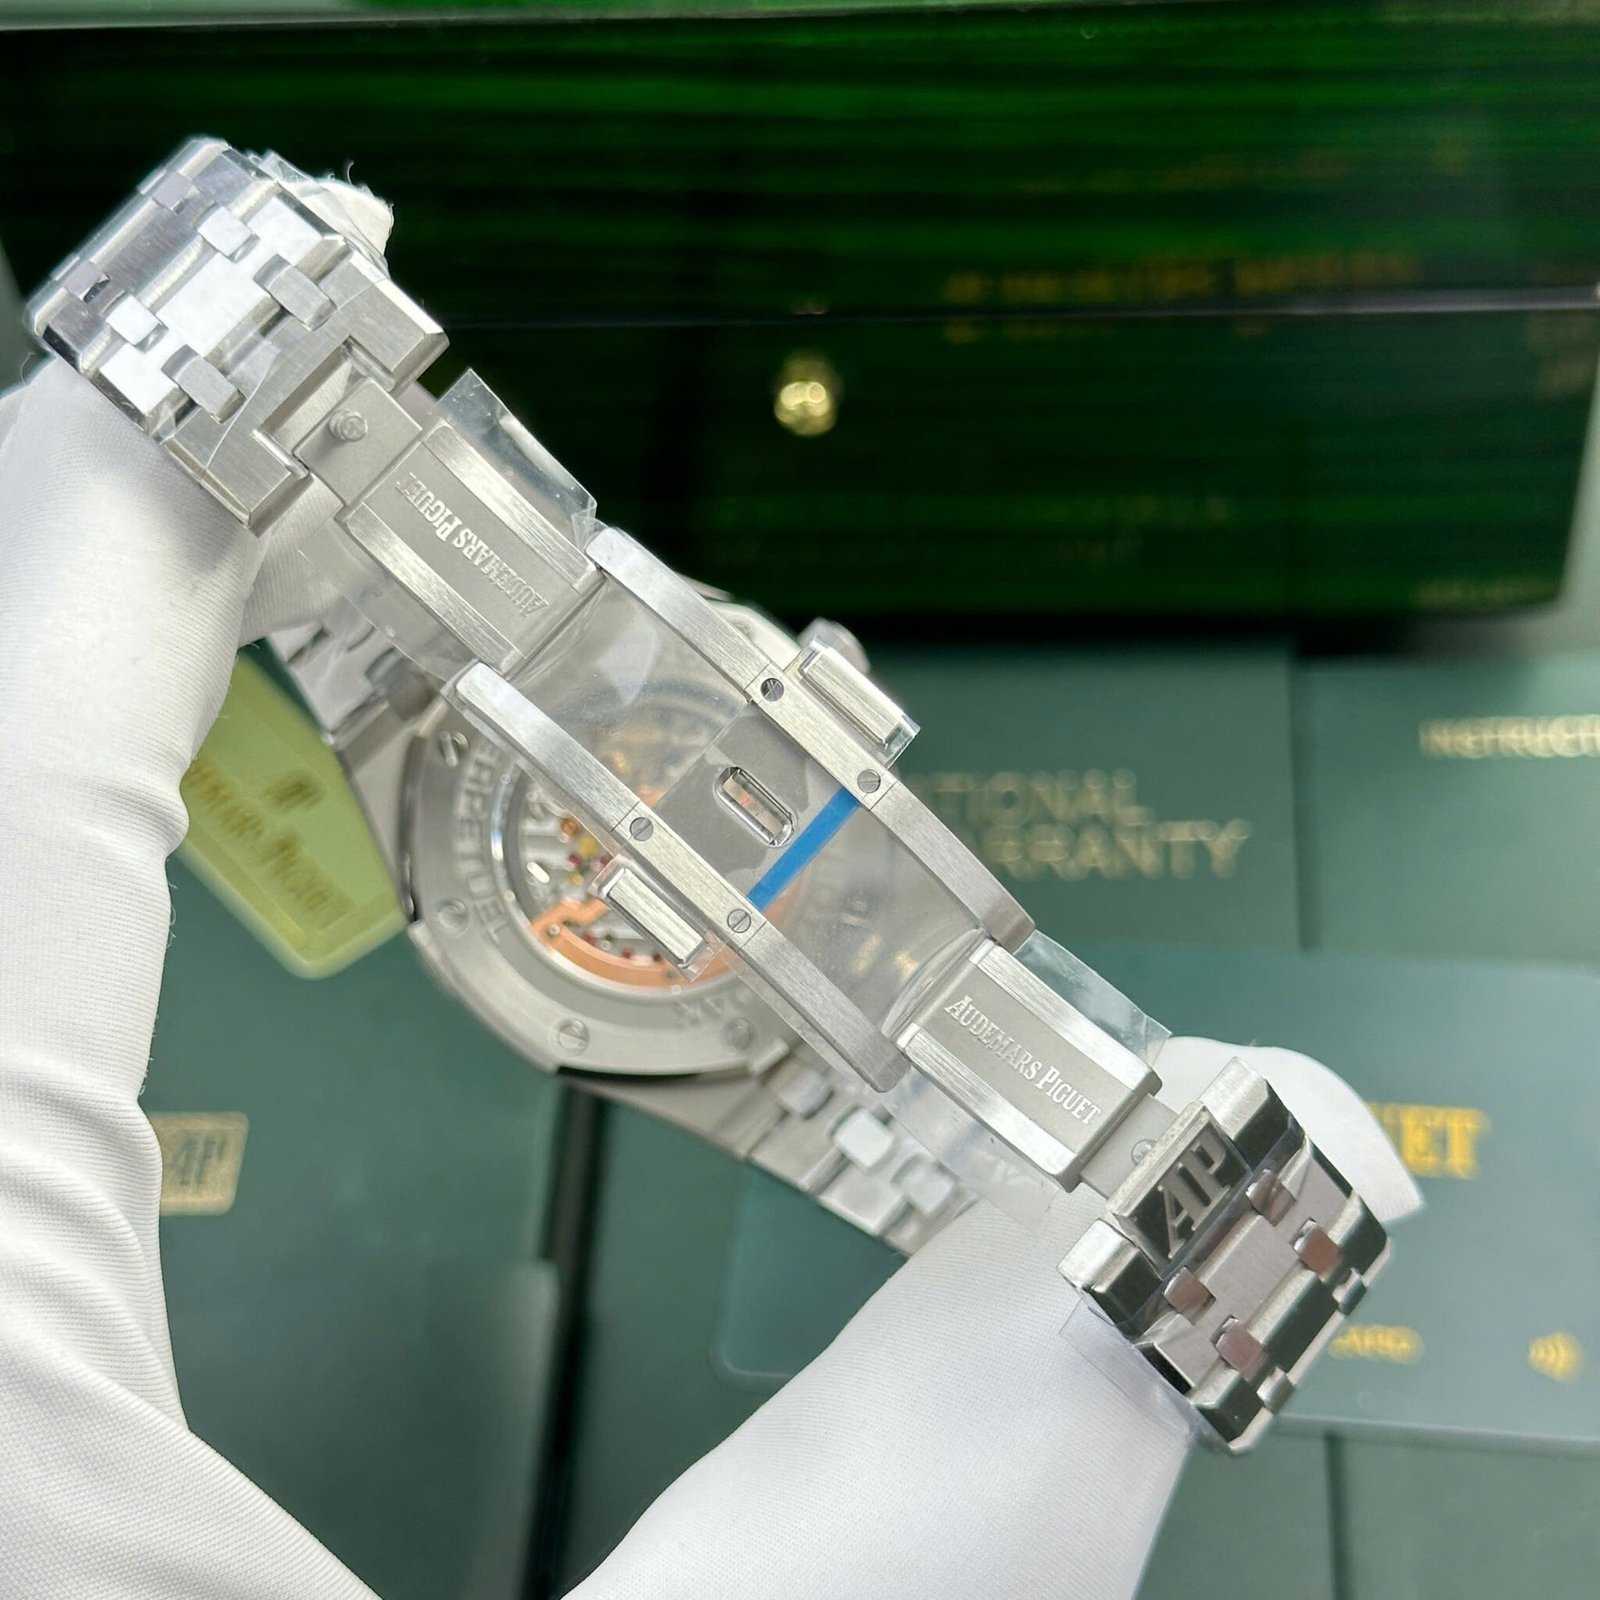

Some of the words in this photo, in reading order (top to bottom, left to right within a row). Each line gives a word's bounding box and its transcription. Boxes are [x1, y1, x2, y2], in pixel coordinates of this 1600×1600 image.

[395, 471, 463, 542] PIGUET
[452, 528, 549, 617] AUDEMARS
[944, 994, 1043, 1080] AUDEMARS
[1035, 1065, 1102, 1125] PIGUET
[1157, 1132, 1231, 1259] AP
